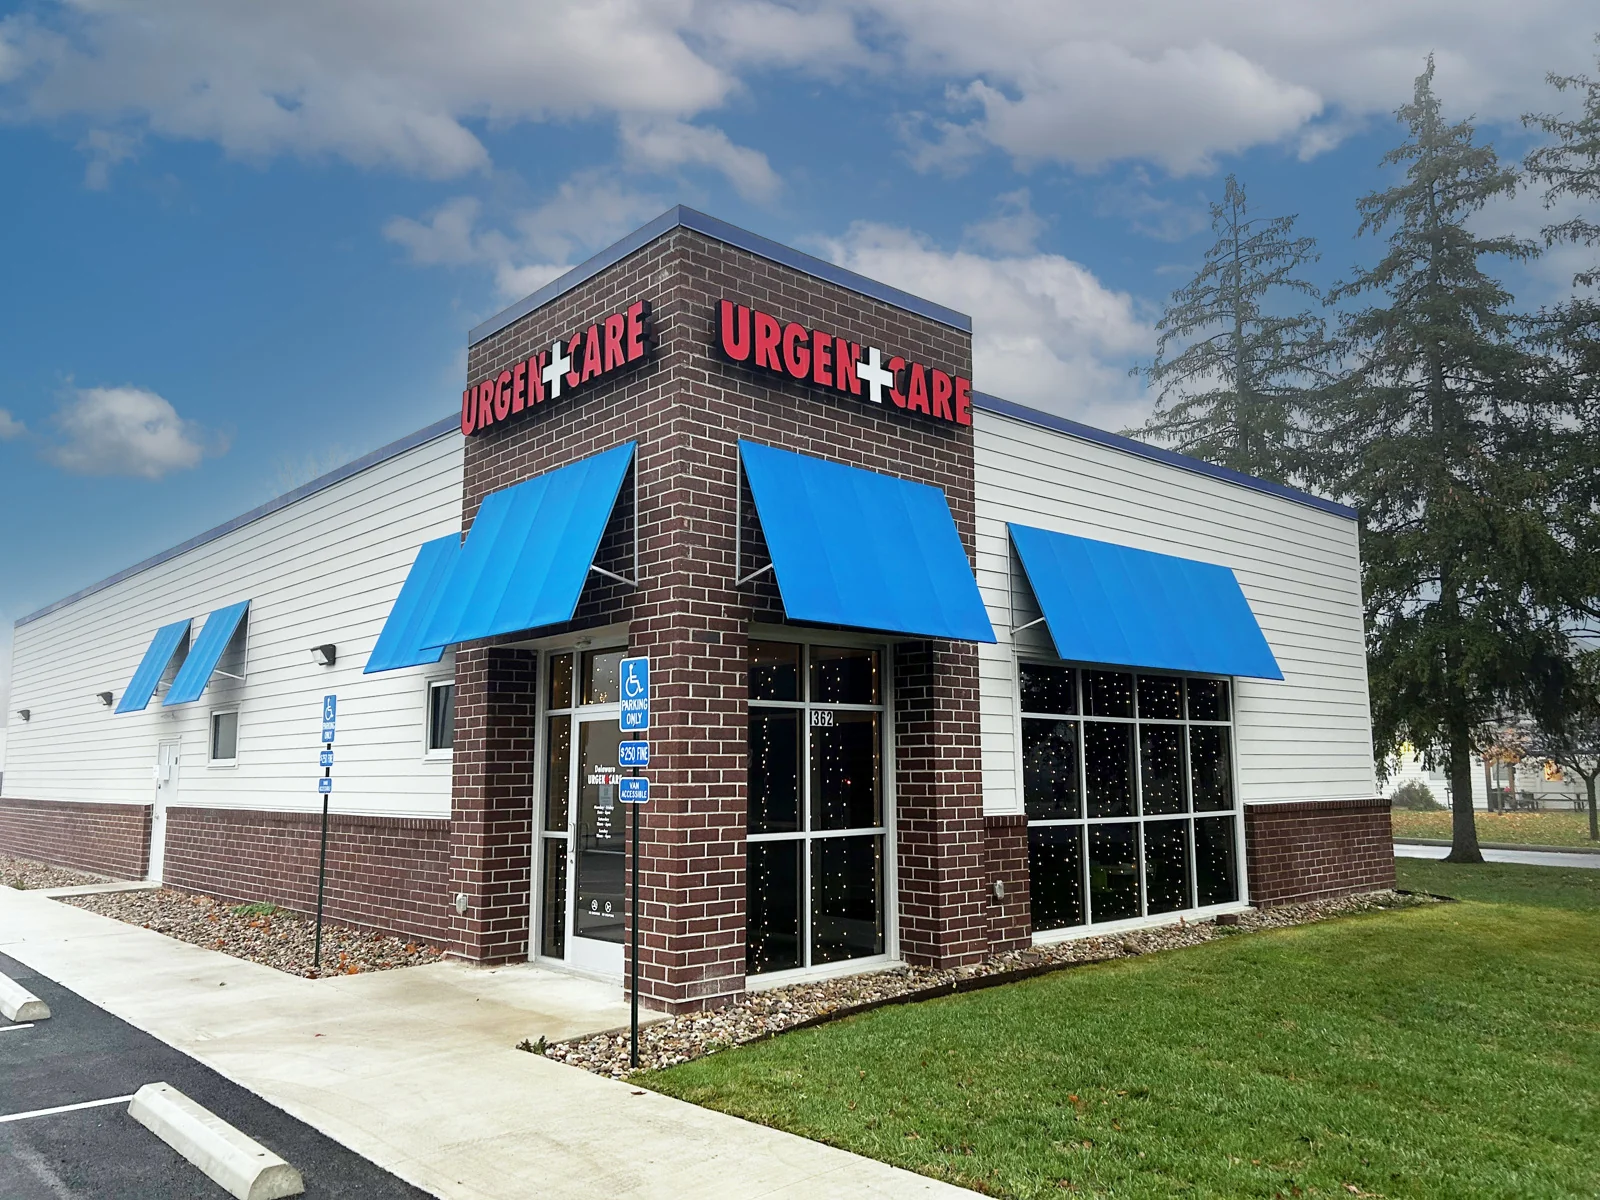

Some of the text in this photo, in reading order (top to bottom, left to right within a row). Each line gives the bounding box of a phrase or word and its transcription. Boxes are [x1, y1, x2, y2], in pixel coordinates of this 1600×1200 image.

[621, 698, 648, 712] PARKING
[626, 712, 643, 726] ONLY
[620, 746, 648, 761] $250 FINE
[594, 764, 616, 773] Delaware
[629, 781, 640, 790] VAN
[621, 789, 647, 799] ACCESSIBLE
